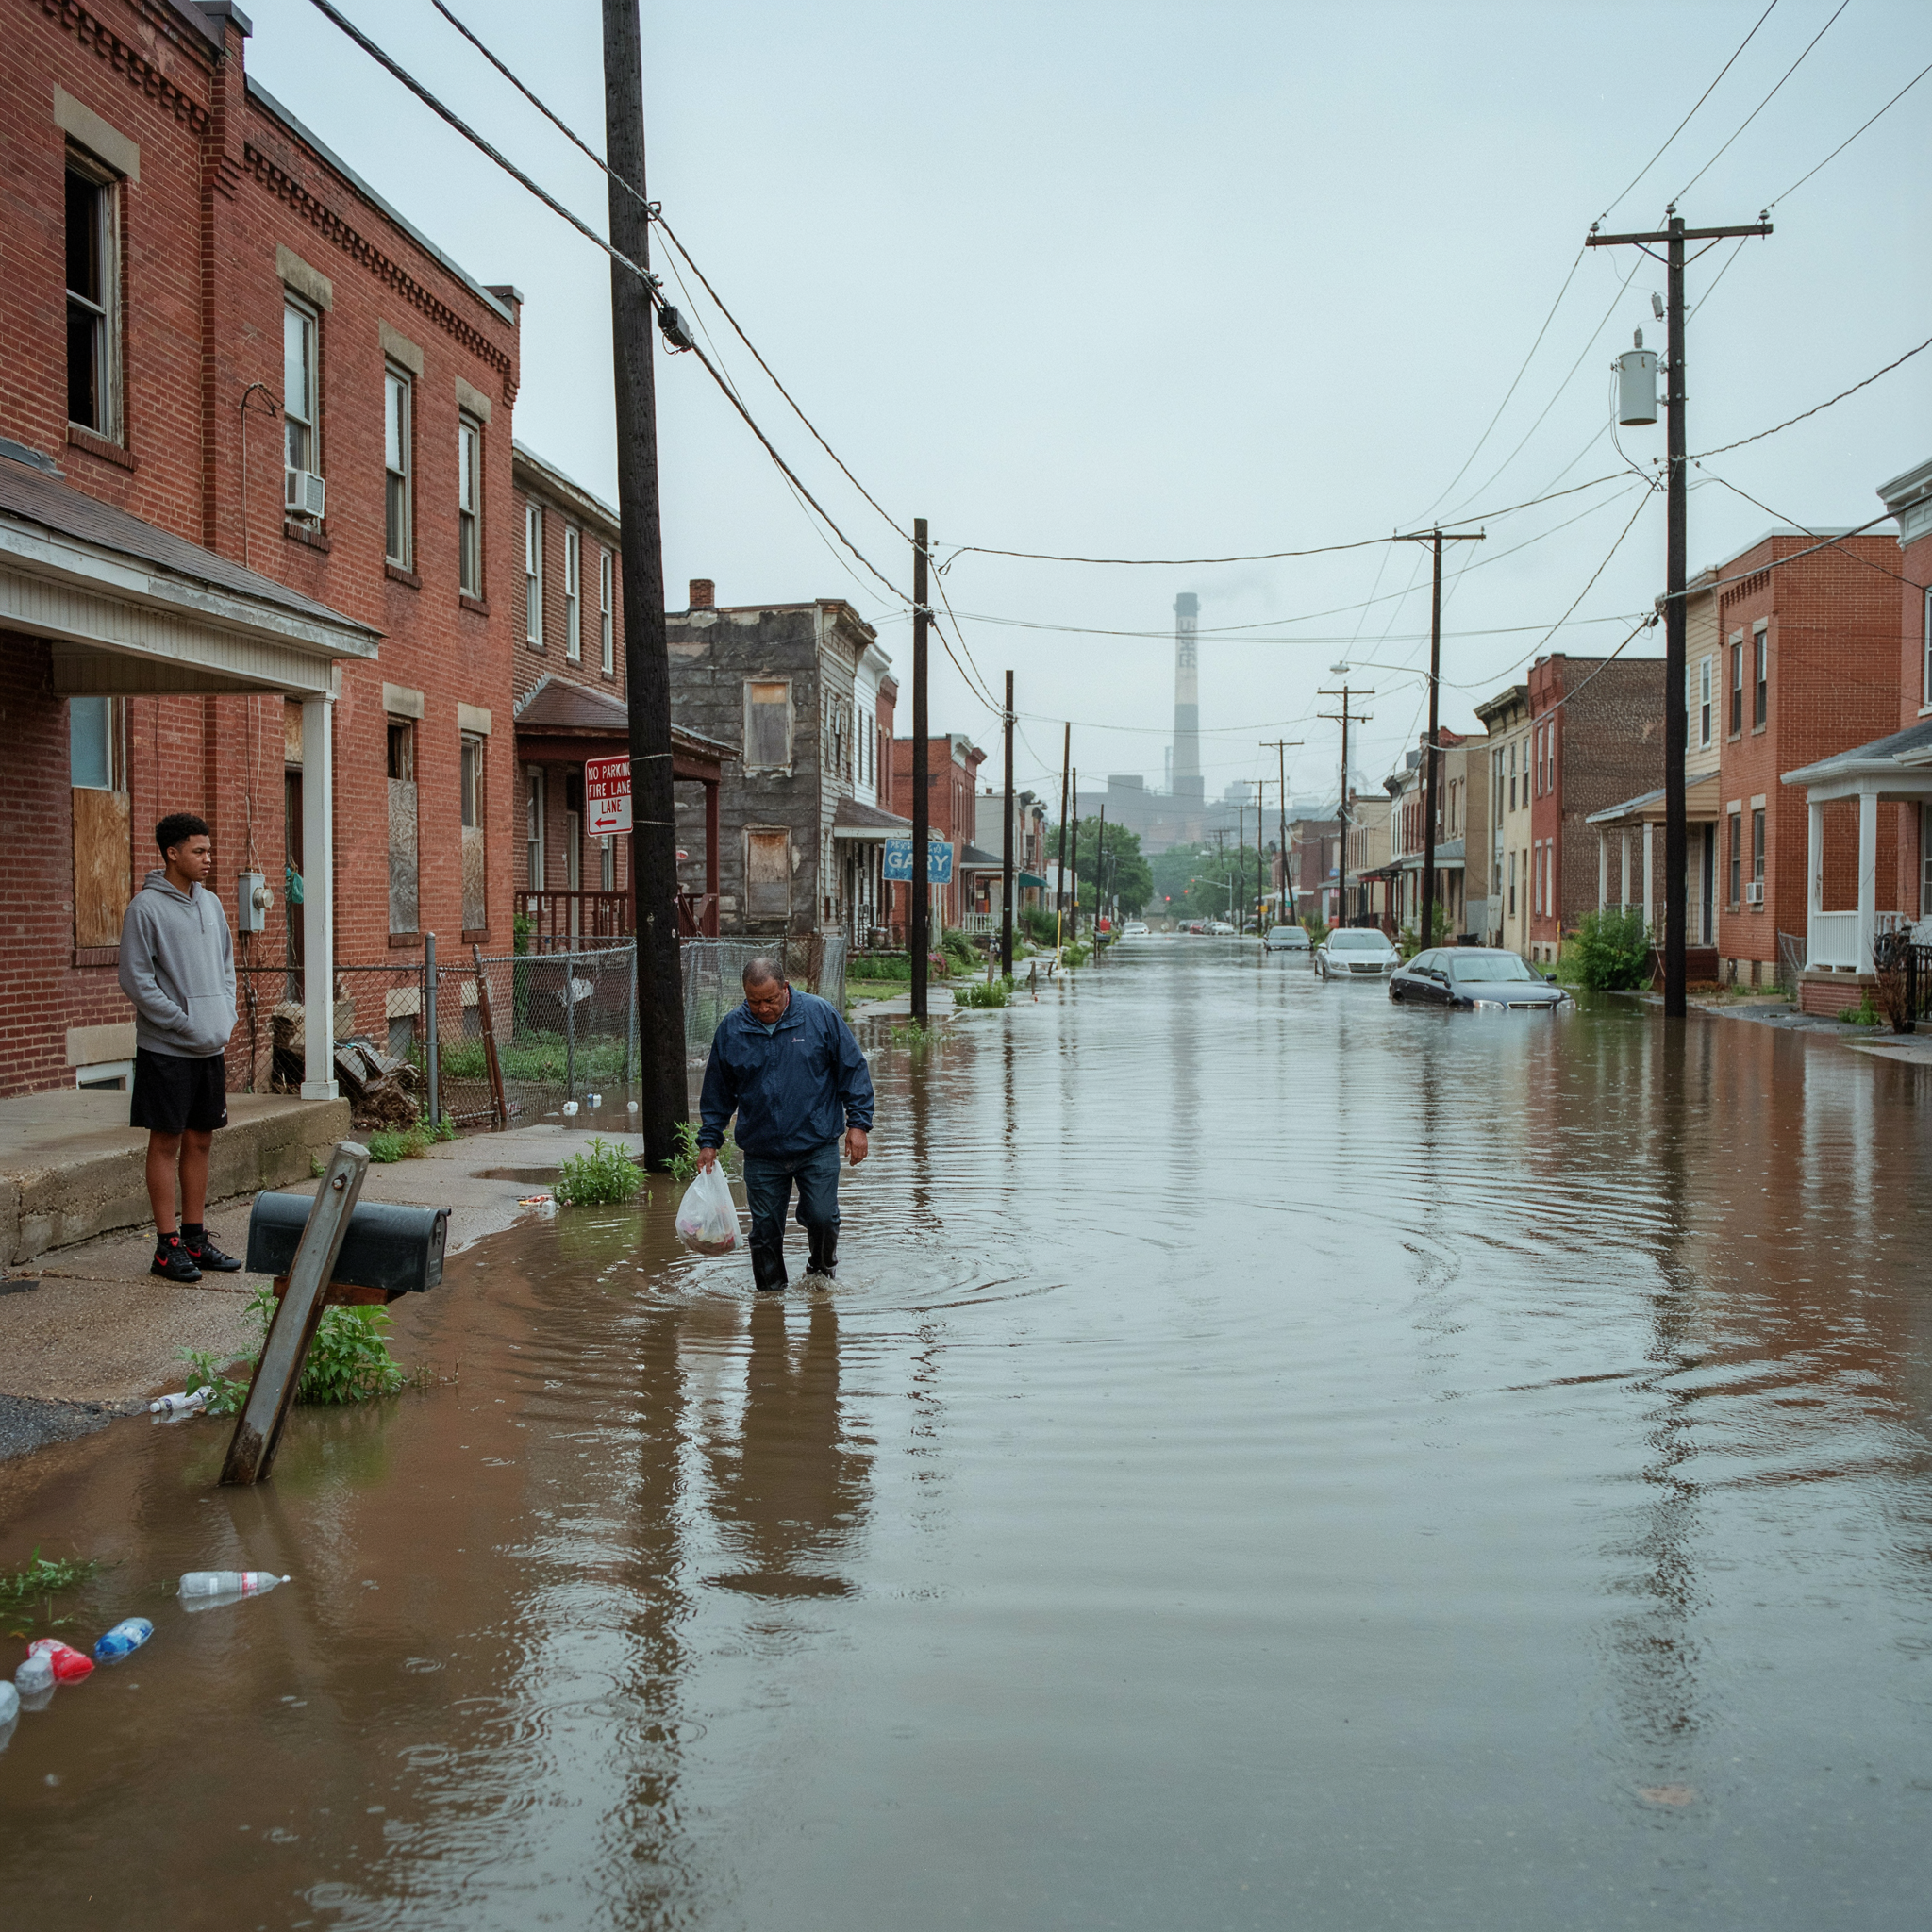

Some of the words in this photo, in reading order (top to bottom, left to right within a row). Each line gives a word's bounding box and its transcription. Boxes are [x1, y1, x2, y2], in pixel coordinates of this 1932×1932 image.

[588, 767, 599, 780] NO
[589, 783, 607, 798] FIRE
[611, 780, 631, 795] LANE
[601, 800, 622, 814] LANE
